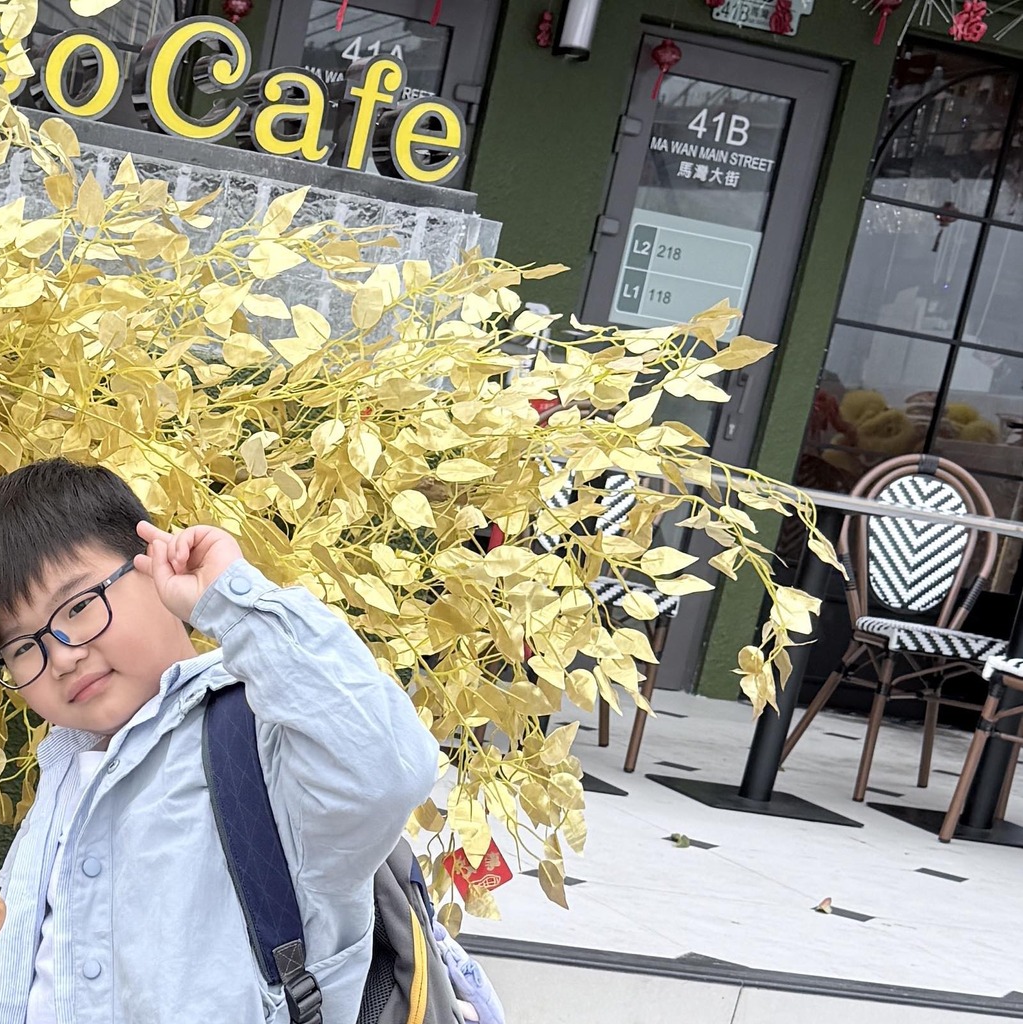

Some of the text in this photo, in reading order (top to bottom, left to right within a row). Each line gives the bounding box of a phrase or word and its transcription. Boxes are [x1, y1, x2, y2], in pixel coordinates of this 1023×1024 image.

[687, 108, 750, 147] 41B
[650, 136, 775, 173] MA WAN MAIN STREET
[677, 161, 741, 188] 馬灣大街
[632, 239, 682, 261] L2 218
[622, 283, 672, 305] L1 118
